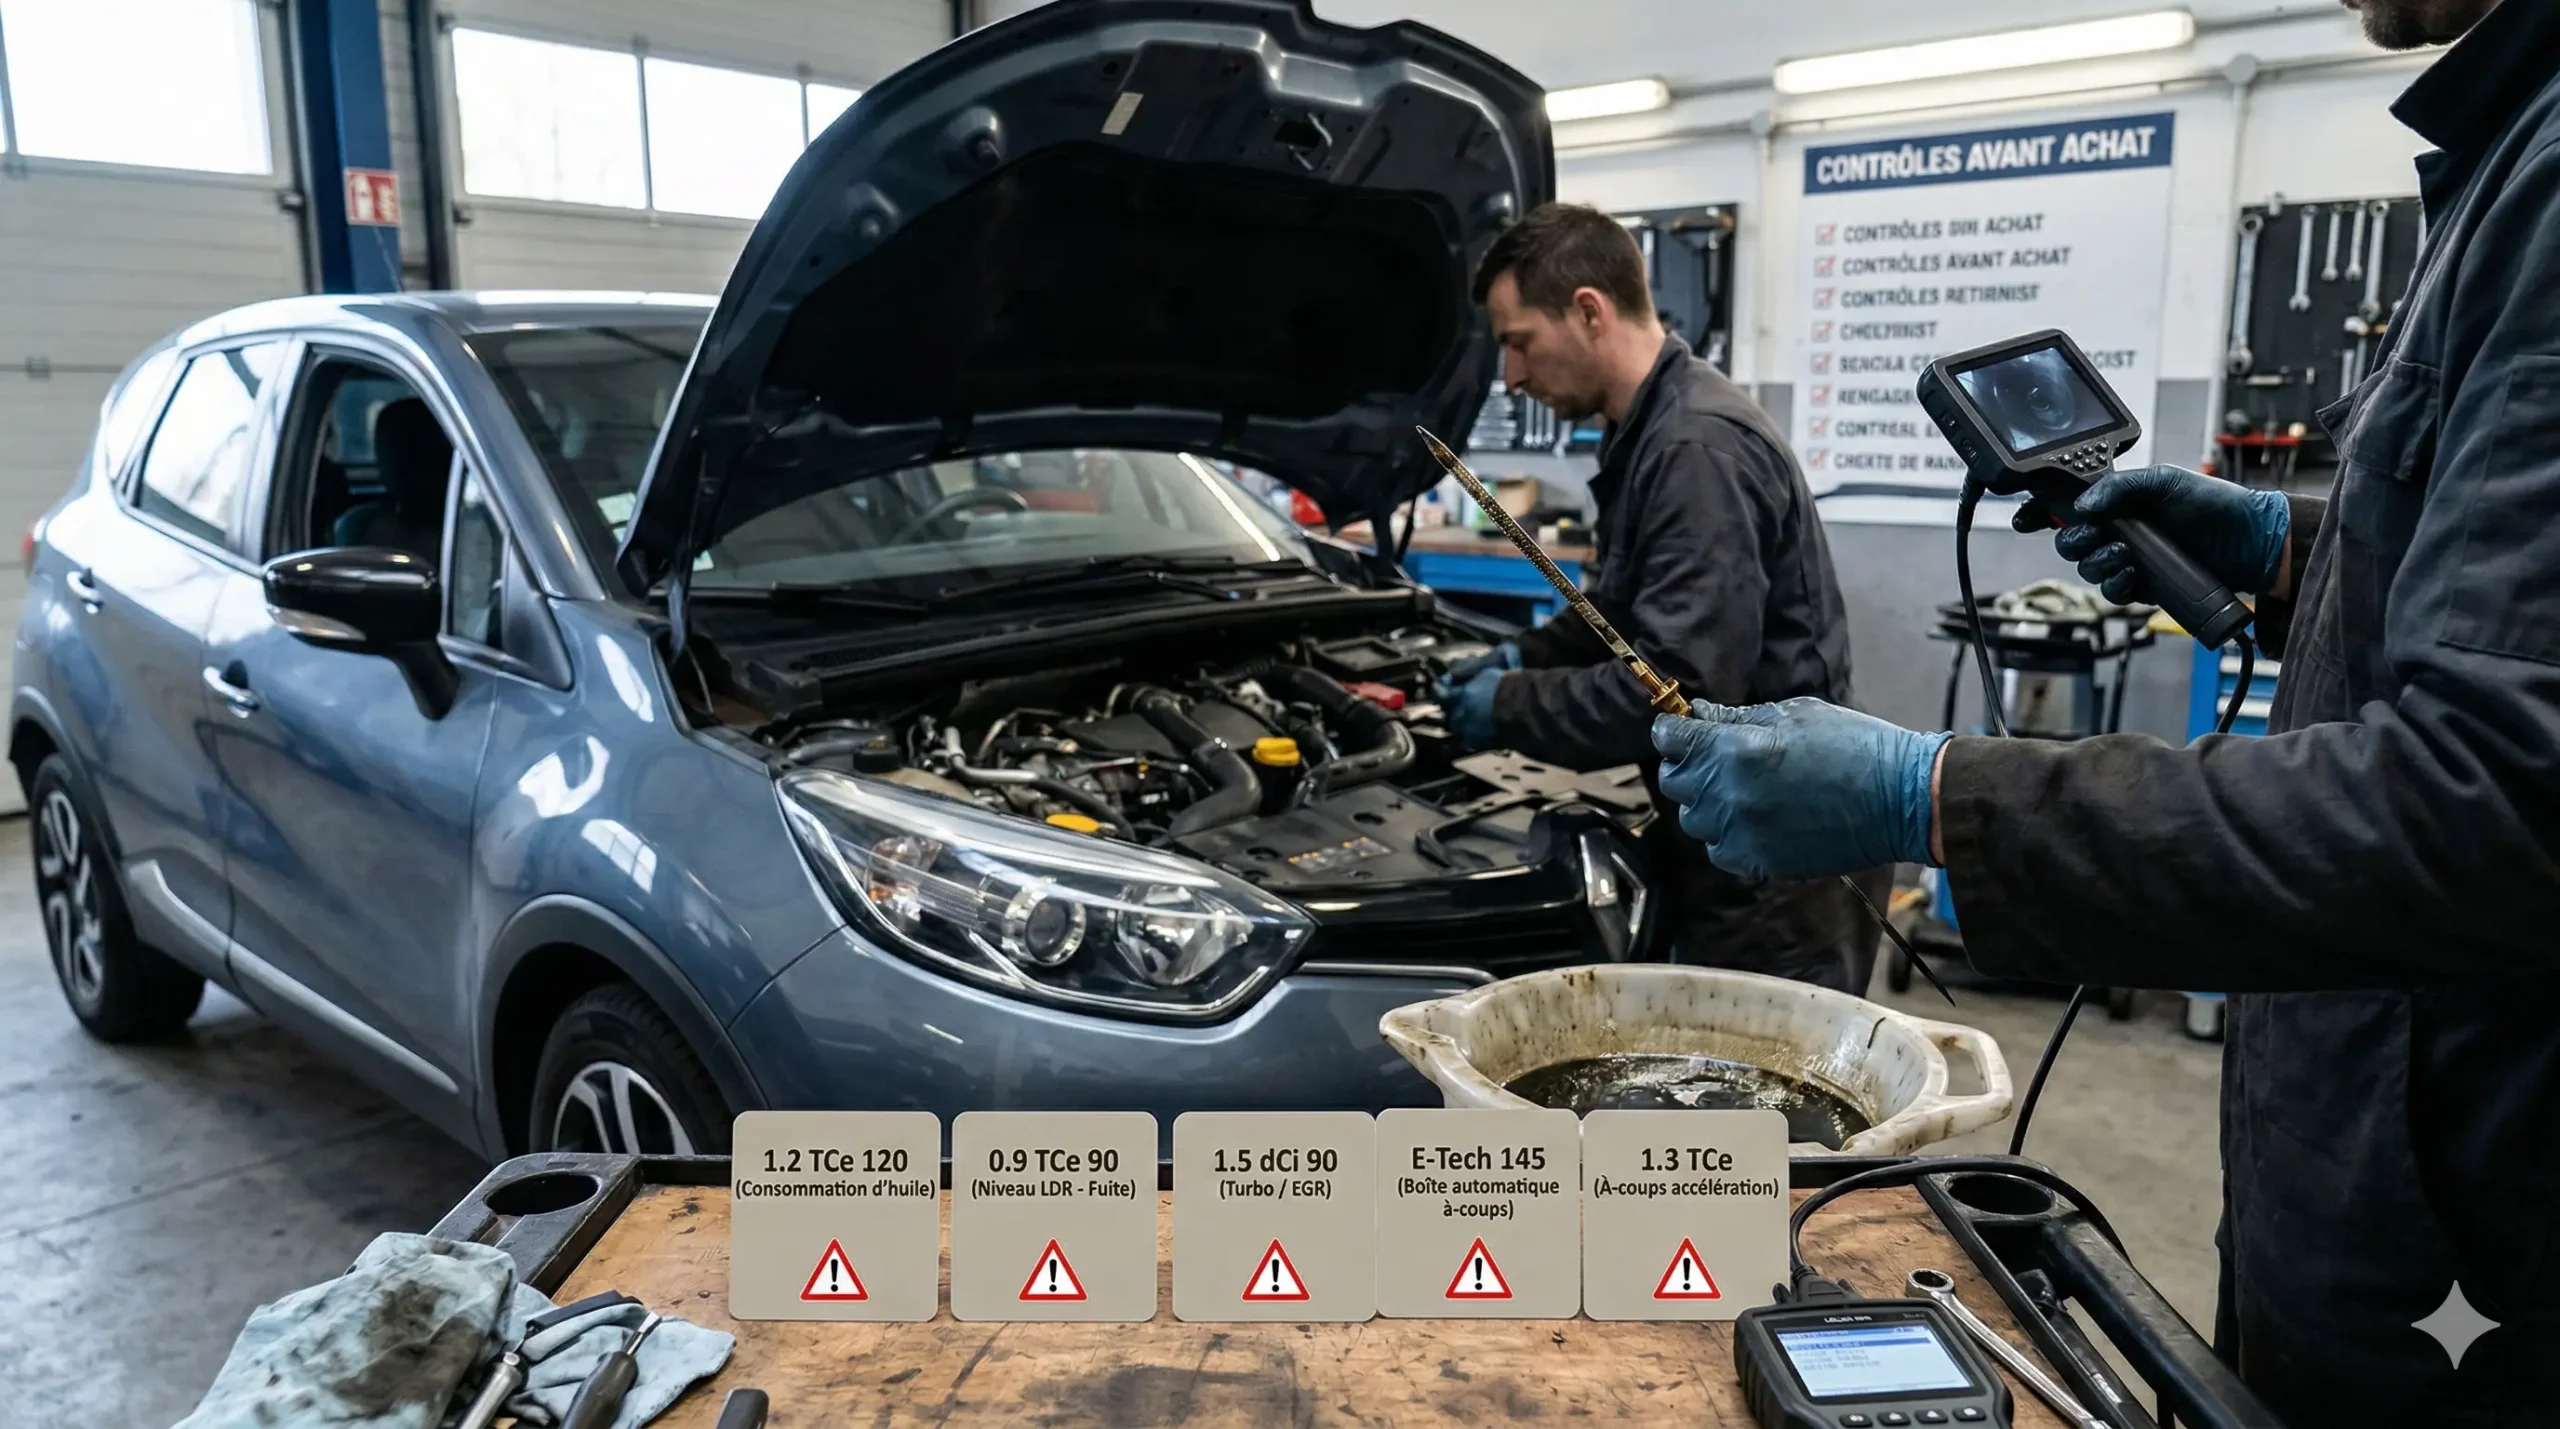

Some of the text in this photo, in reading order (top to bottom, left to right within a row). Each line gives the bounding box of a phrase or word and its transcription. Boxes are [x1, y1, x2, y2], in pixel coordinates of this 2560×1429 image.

[1816, 126, 2156, 185] CONTRÔLES AVANT ACHAT
[1844, 218, 1942, 243] CONTRÔLES
[1984, 213, 2045, 235] ACHAT
[1842, 247, 2071, 276] CONTRÔLES AVANT ACHAT
[1841, 286, 1940, 309] CONTRÔLES
[765, 1149, 907, 1172] 1.2 TCe 120
[989, 1149, 1118, 1172] 0.9 TCe 90
[1215, 1147, 1337, 1172] 1.5 dCi 90
[1413, 1146, 1545, 1170] E-Tech 145
[1642, 1148, 1732, 1171] 1.3 TCe
[736, 1179, 867, 1199] (Consommation
[972, 1179, 1035, 1199] (Niveau
[1041, 1180, 1072, 1197] LDR
[1089, 1179, 1135, 1200] Fuite)
[1220, 1179, 1331, 1199] (Turbo / EGR)
[1398, 1177, 1559, 1197] (Boîte automatique
[1594, 1174, 1779, 1199] (À-coups accélération)
[1443, 1199, 1513, 1220] à-coups)
